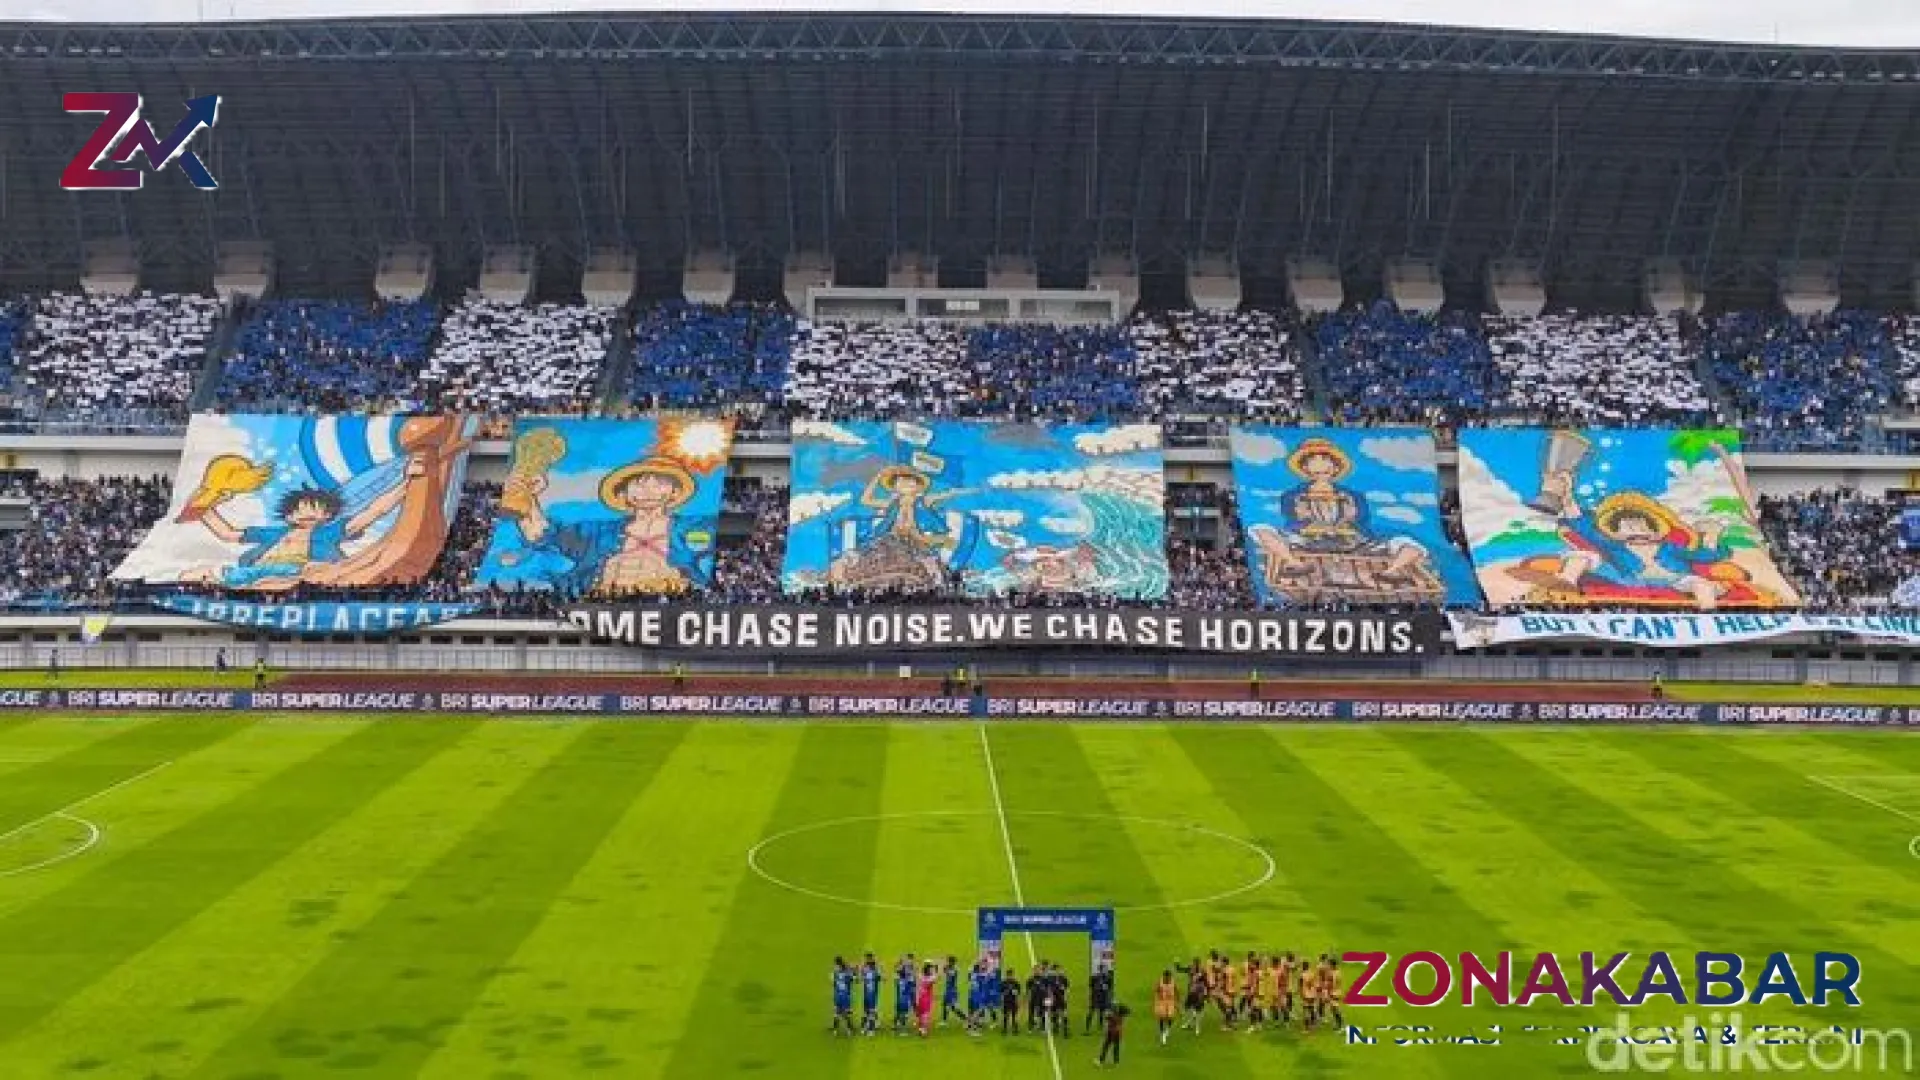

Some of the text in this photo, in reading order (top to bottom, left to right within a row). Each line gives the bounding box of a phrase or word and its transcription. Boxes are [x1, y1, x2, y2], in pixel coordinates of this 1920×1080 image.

[677, 611, 818, 647] CHASE
[1046, 614, 1185, 647] CHASE
[1200, 617, 1425, 654] HORIZONS.
